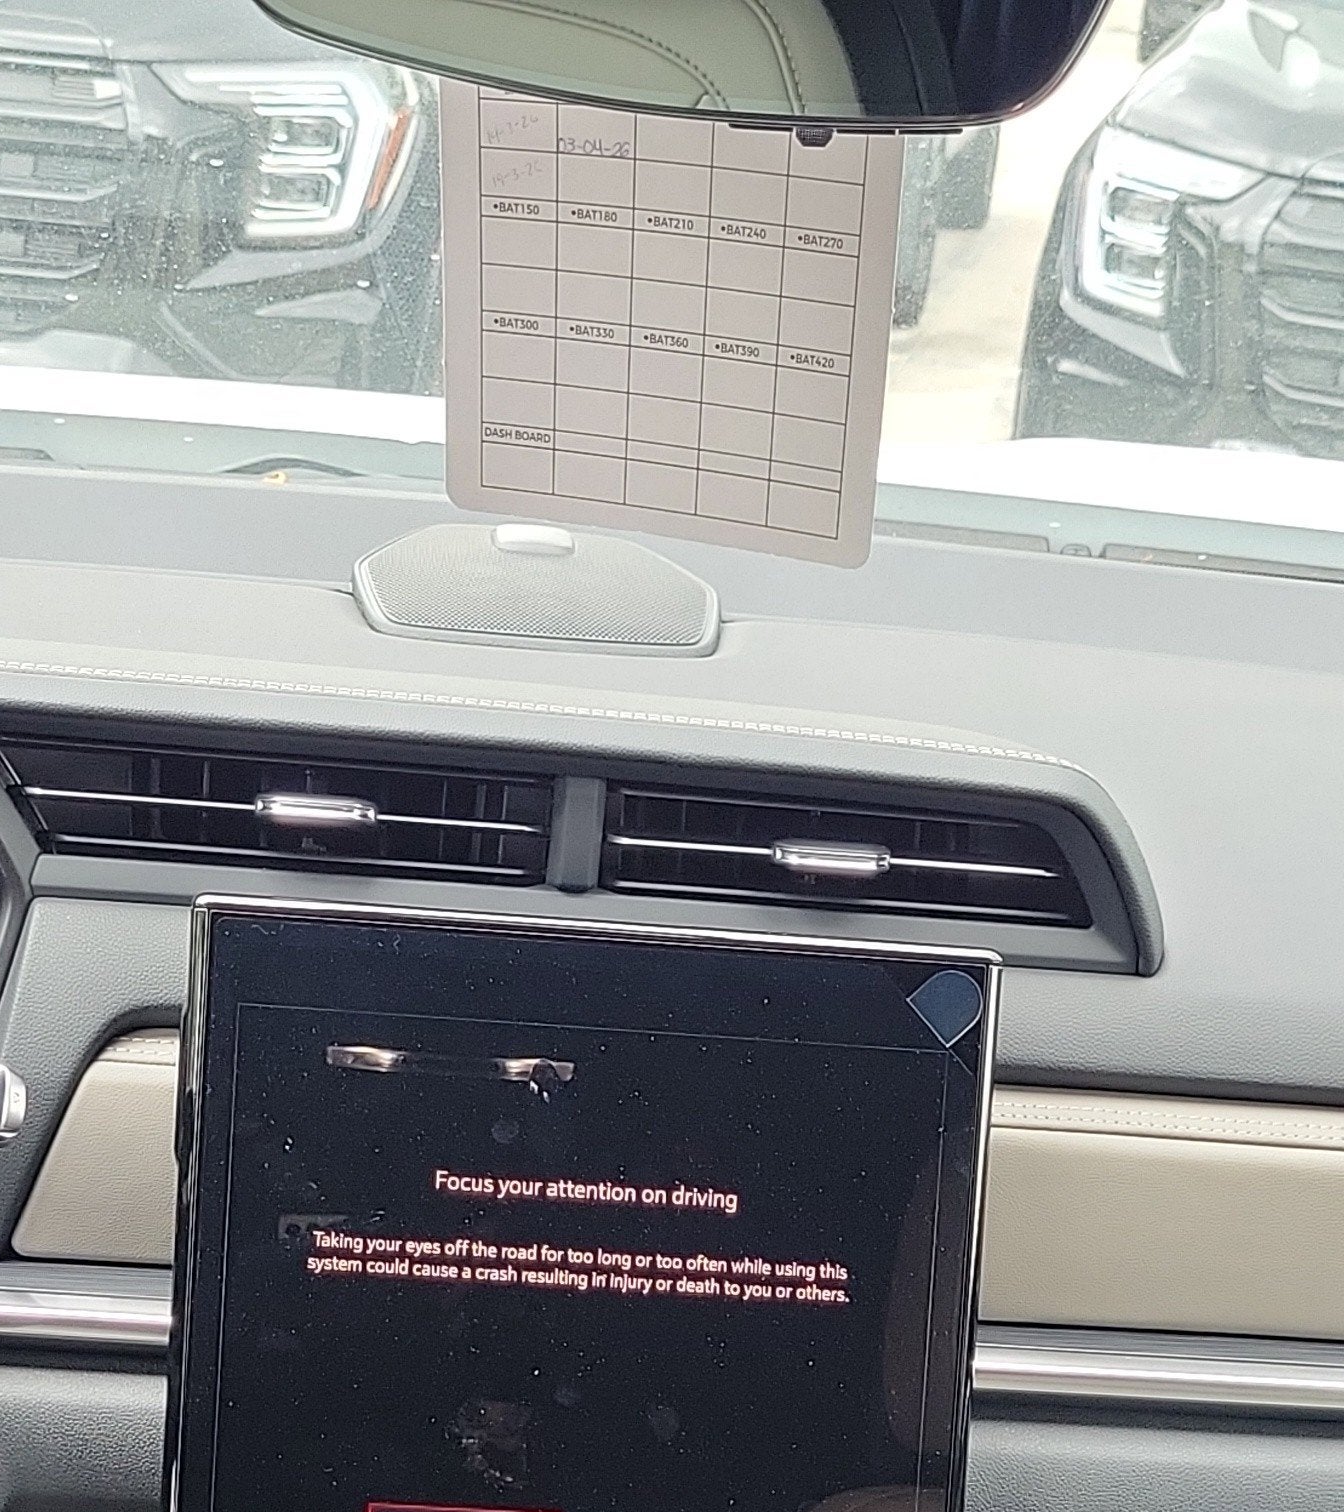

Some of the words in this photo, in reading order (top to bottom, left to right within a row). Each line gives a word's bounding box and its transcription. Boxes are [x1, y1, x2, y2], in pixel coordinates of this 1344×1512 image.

[484, 427, 512, 439] DASH
[515, 430, 551, 443] BOARD
[435, 1170, 494, 1193] Focus
[497, 1179, 543, 1199] your
[546, 1179, 635, 1202] attention
[642, 1190, 666, 1204] on
[672, 1185, 738, 1213] driving
[313, 1231, 363, 1254] Taking
[366, 1238, 403, 1254] your
[405, 1241, 440, 1257] eyes
[445, 1239, 470, 1256] off
[472, 1241, 497, 1258] the
[501, 1244, 537, 1260] road
[541, 1244, 564, 1261] for
[567, 1249, 593, 1264] too
[597, 1248, 631, 1270] long
[635, 1256, 652, 1268] or
[656, 1254, 683, 1269] too
[686, 1255, 727, 1273] often
[731, 1258, 771, 1275] while
[775, 1262, 815, 1281] using
[819, 1263, 848, 1280] this
[307, 1256, 362, 1273] system
[366, 1259, 409, 1275] could
[412, 1265, 458, 1278] cause
[461, 1266, 472, 1278] a
[475, 1267, 517, 1282] crash
[521, 1269, 588, 1290] resulting
[592, 1273, 606, 1288] in
[610, 1274, 652, 1294] injury
[656, 1279, 673, 1292] or
[676, 1277, 720, 1295] death
[724, 1281, 740, 1295] to
[743, 1284, 771, 1300] you
[776, 1286, 793, 1298] or
[796, 1285, 850, 1302] others.
